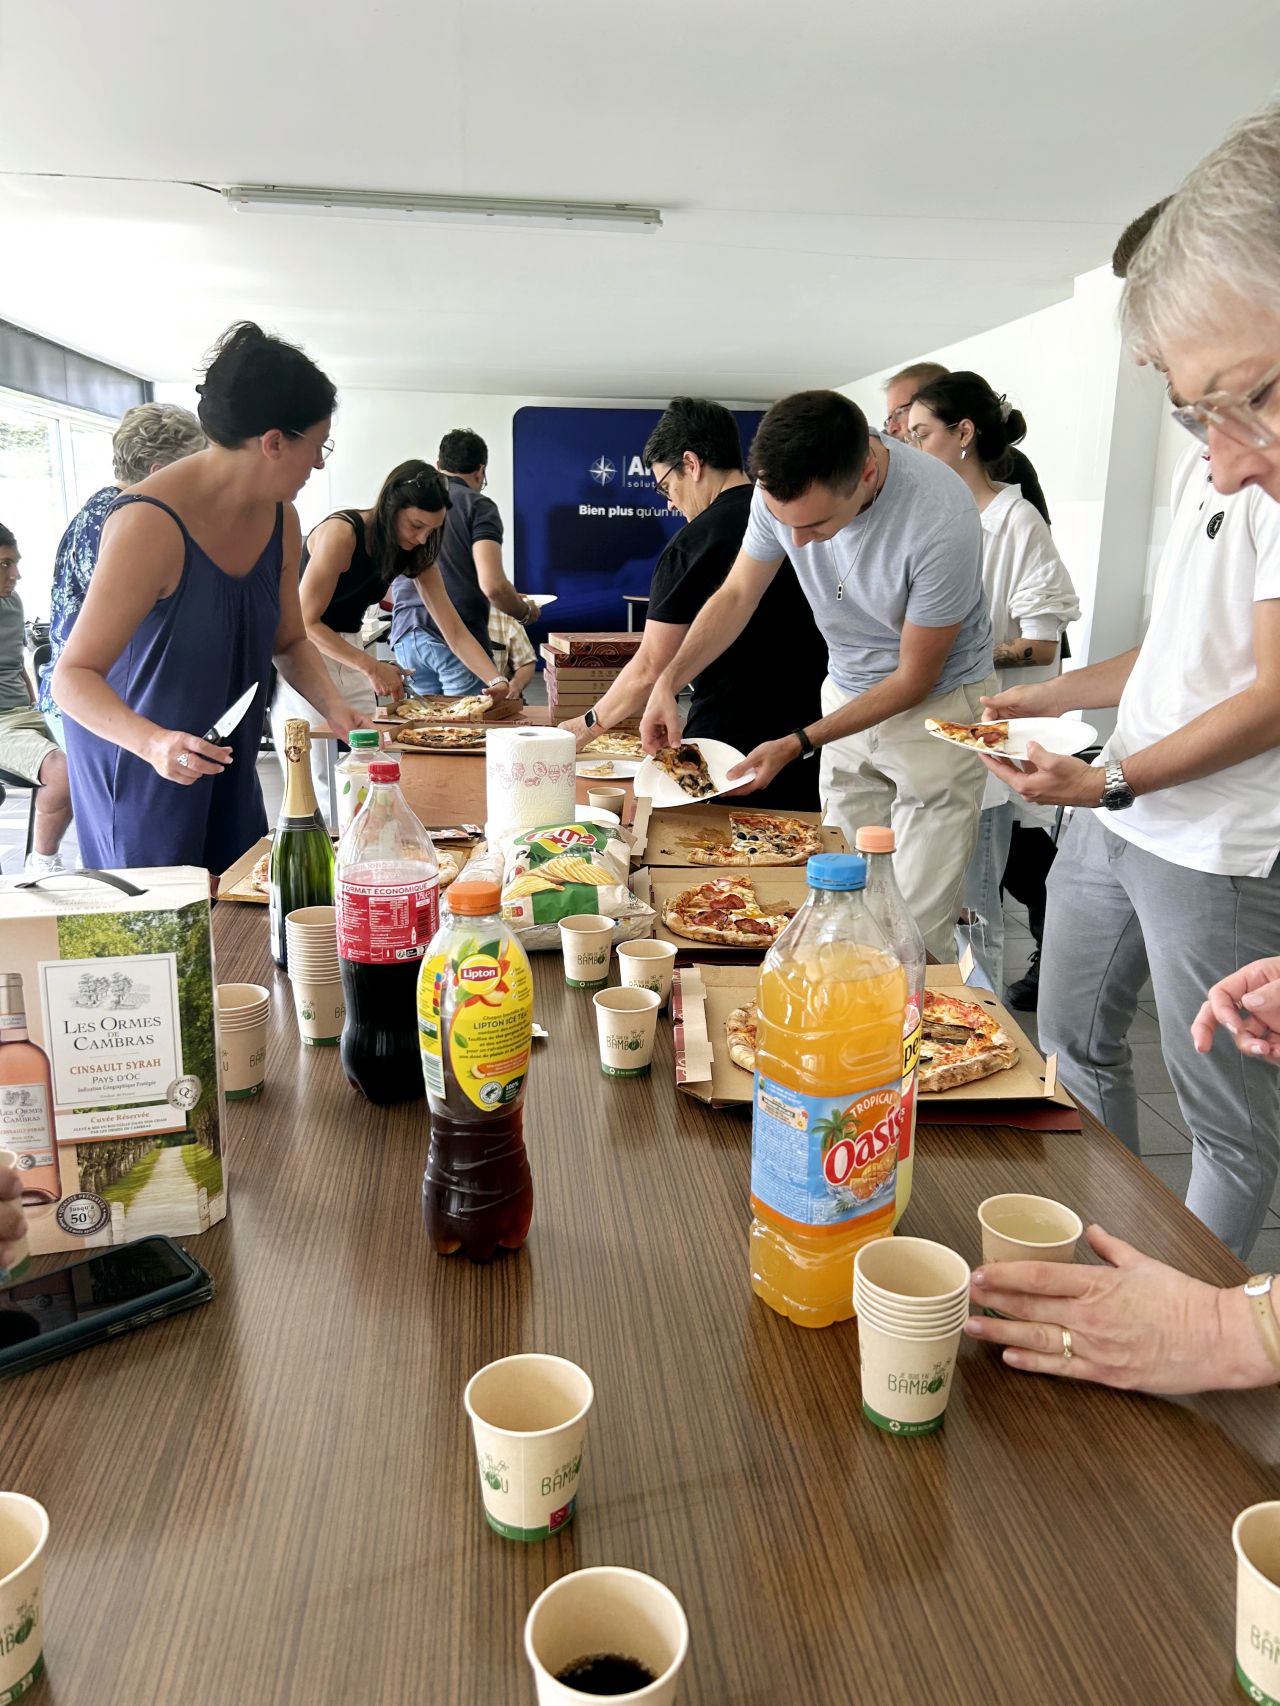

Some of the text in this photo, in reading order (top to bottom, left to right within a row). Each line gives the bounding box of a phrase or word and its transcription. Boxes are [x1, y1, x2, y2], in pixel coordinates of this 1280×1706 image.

[578, 504, 605, 516] Bien
[608, 505, 634, 518] plus
[636, 507, 669, 518] qu'un
[342, 884, 371, 895] FORMAT
[463, 968, 496, 979] Lipton
[64, 1016, 162, 1035] LES ORMES
[473, 1020, 505, 1030] LIPTON
[505, 1015, 516, 1025] ICE
[73, 1034, 155, 1051] CAMBRAS
[70, 1059, 161, 1076] CINSAULT SYRAH
[92, 1073, 141, 1084] PAYS D'OC
[849, 1093, 893, 1118] TROPICAL
[91, 1112, 150, 1123] Cuvée Réservée
[824, 1104, 901, 1185] Oasis
[71, 1213, 87, 1224] 50
